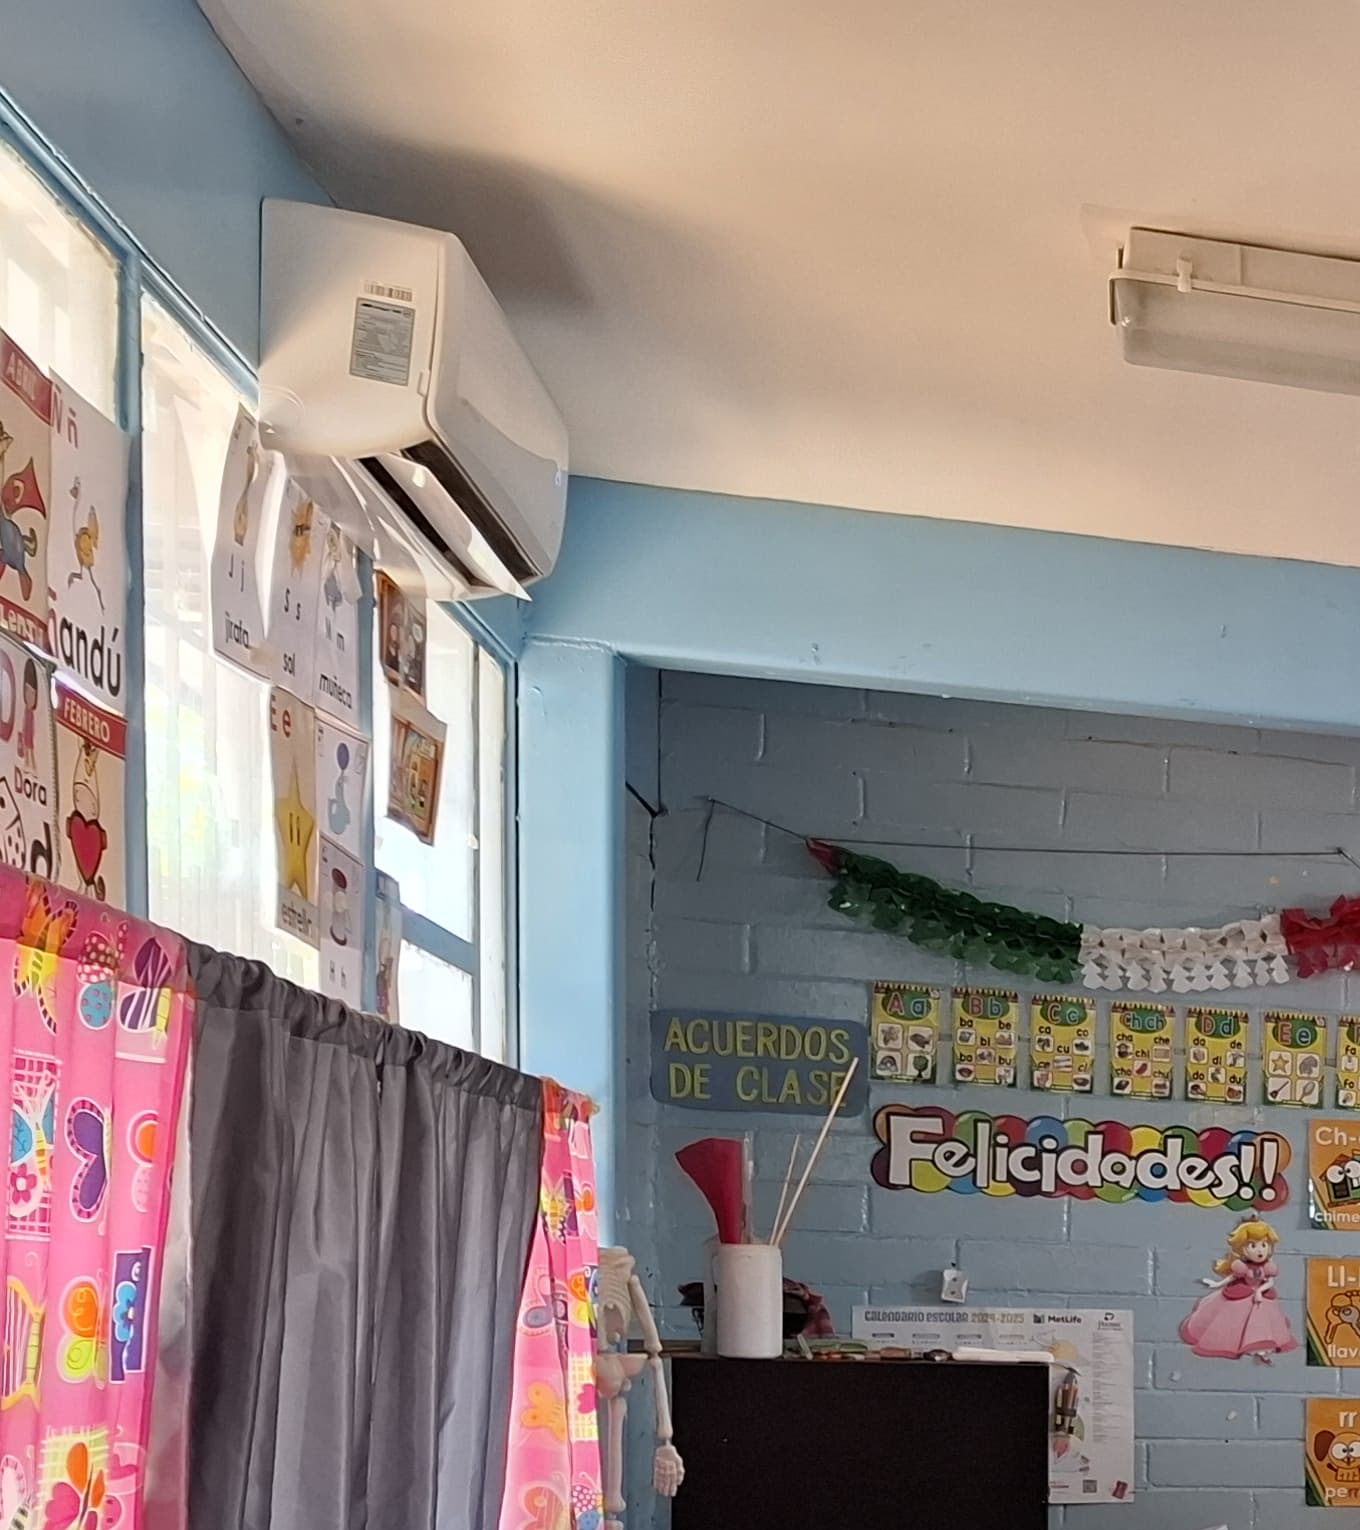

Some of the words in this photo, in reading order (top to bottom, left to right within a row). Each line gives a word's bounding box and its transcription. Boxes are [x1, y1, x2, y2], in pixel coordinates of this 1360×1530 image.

[67, 407, 79, 450] ñ
[224, 611, 251, 649] jirafa
[283, 652, 296, 677] sol
[318, 671, 353, 709] muñeca
[62, 698, 111, 744] FEBRERO
[14, 766, 47, 806] Dora
[887, 992, 905, 1016] A
[911, 1000, 927, 1015] a
[968, 995, 984, 1017] B
[988, 997, 1001, 1018] b
[998, 1020, 1012, 1031] be
[1202, 1016, 1215, 1036] D
[1220, 1017, 1234, 1036] d
[1278, 1021, 1292, 1045] E
[1296, 1028, 1311, 1045] e
[664, 1017, 849, 1064] ACUERDOS
[1116, 1033, 1133, 1043] cha
[1153, 1036, 1171, 1045] che
[1230, 1040, 1242, 1050] de
[669, 1063, 712, 1099] DE
[736, 1065, 848, 1107] CLASE
[1229, 1074, 1242, 1085] du
[886, 1114, 1278, 1201] Felicidades!!
[1048, 1314, 1082, 1324] MetLife
[1338, 1410, 1358, 1429] rr
